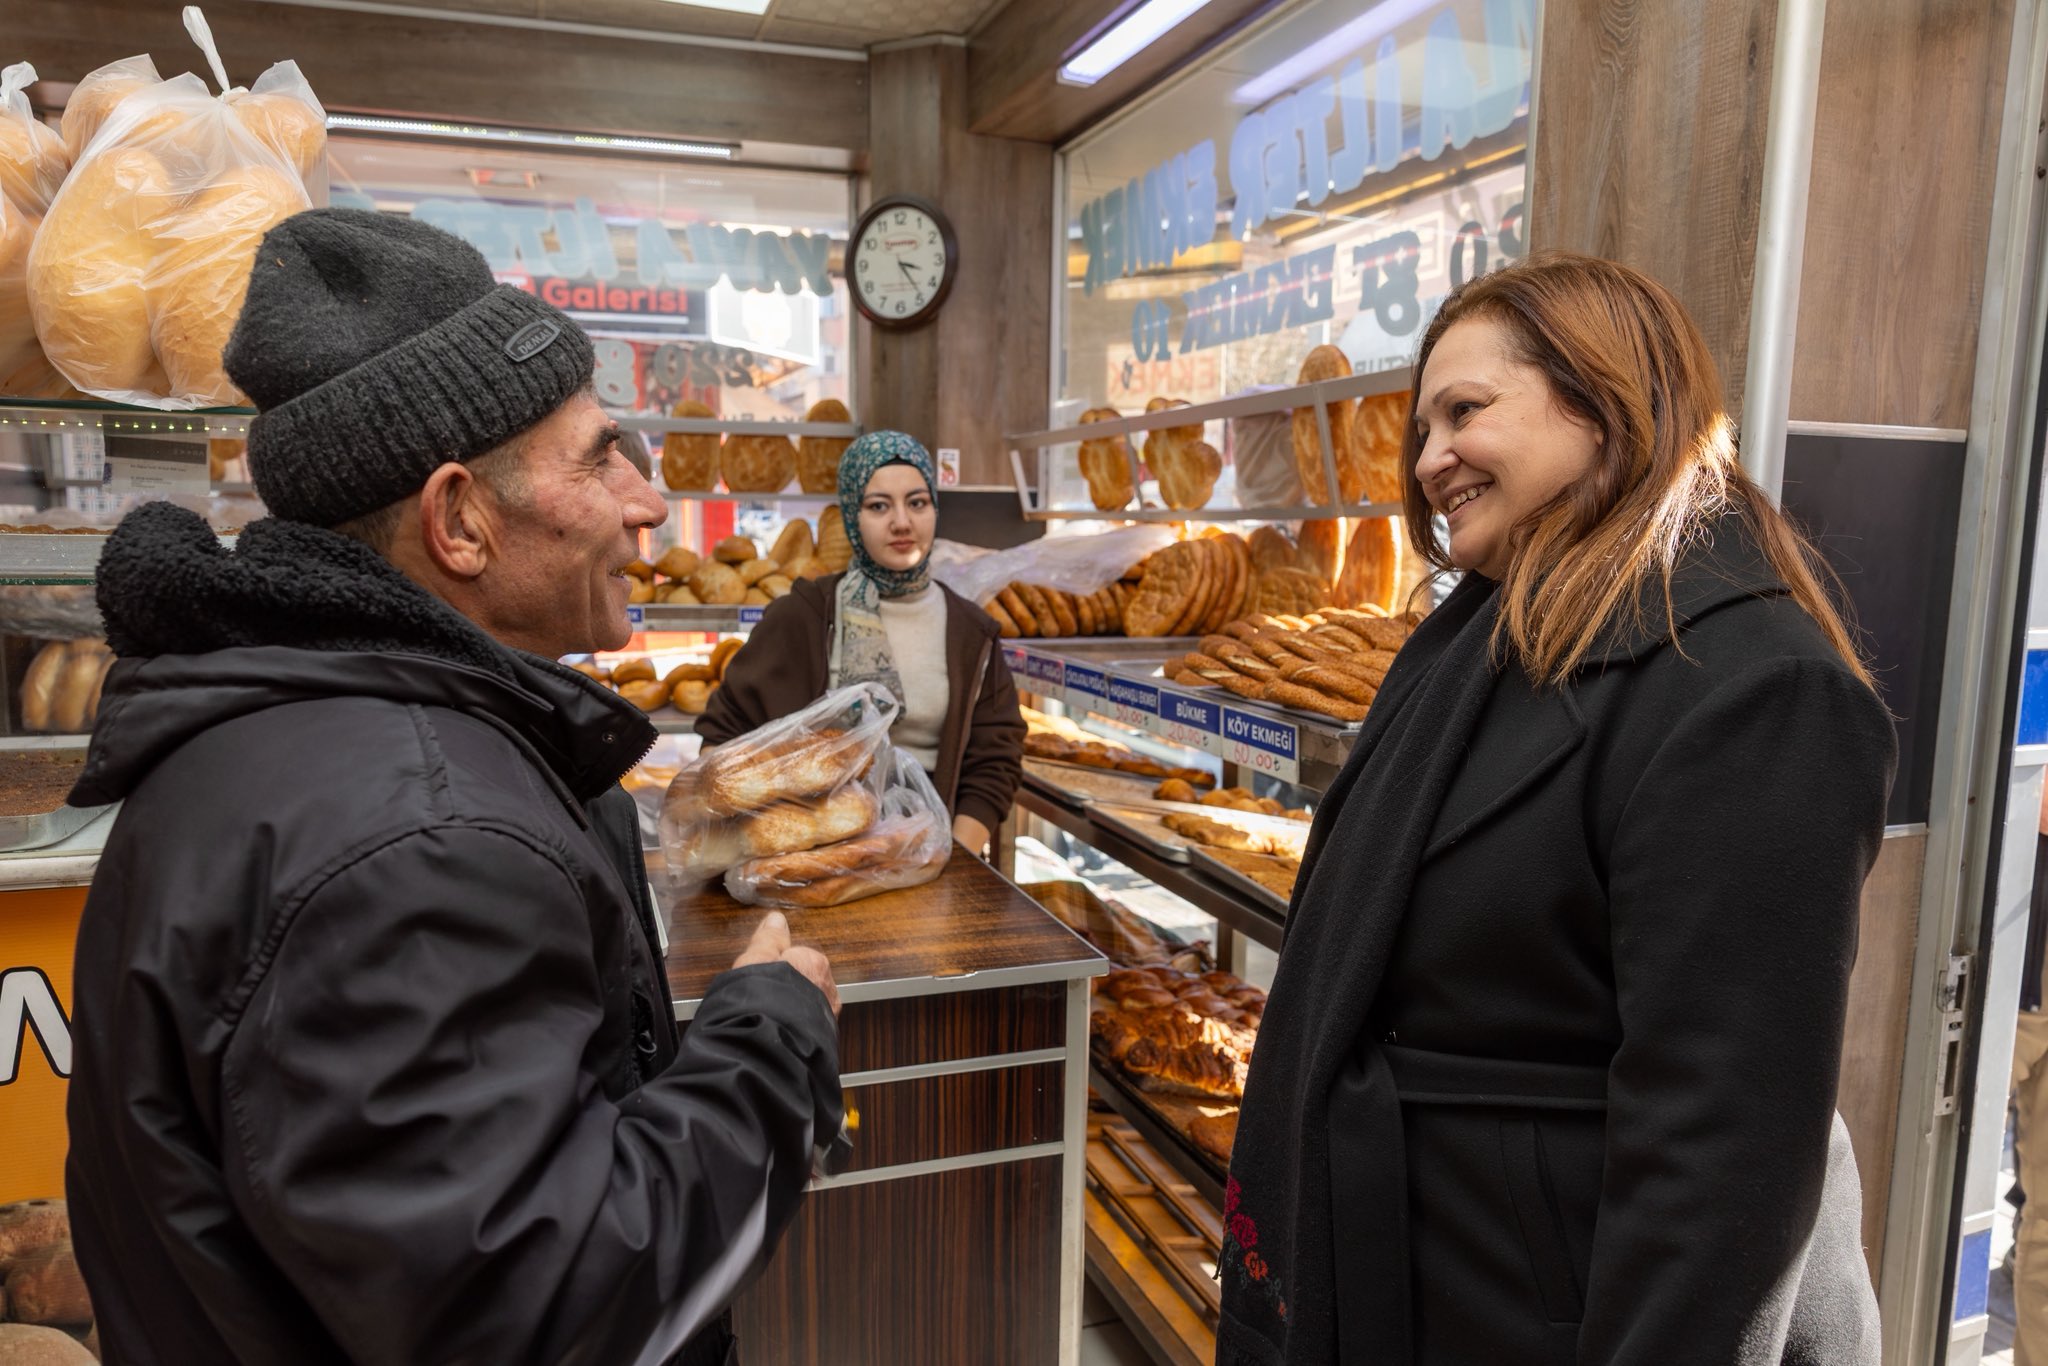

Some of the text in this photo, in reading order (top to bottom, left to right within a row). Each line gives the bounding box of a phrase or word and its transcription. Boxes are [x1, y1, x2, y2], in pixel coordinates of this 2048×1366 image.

[894, 211, 907, 226] 12
[916, 216, 922, 229] 1
[877, 220, 888, 233] 11
[866, 239, 878, 251] 10
[928, 231, 937, 245] 2
[858, 259, 869, 273] 9
[934, 253, 944, 266] 3
[864, 280, 874, 294] 8
[927, 275, 937, 288] 4
[541, 276, 688, 313] Galerisi
[915, 292, 925, 306] 5
[879, 296, 888, 309] 7
[895, 301, 906, 314] 6
[1176, 701, 1207, 724] BÜKME
[1227, 716, 1292, 752] KÖY EKMEĞİ
